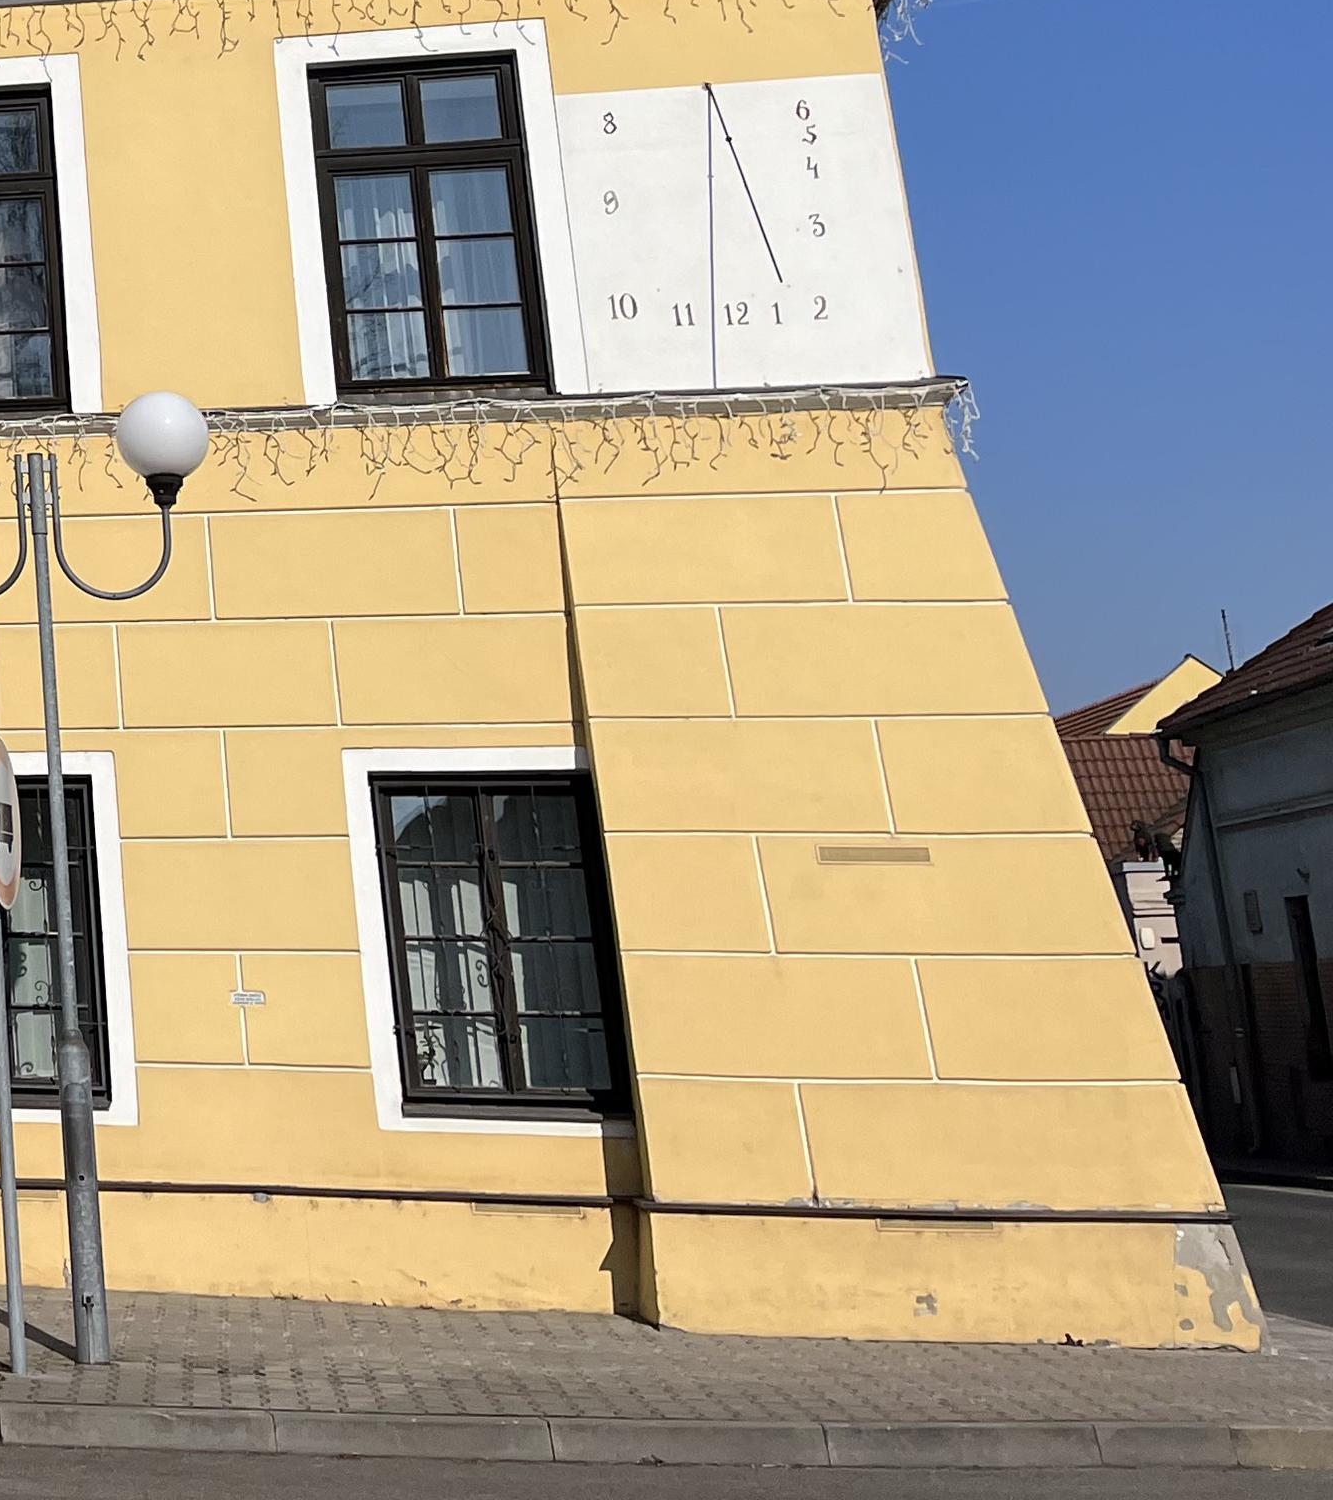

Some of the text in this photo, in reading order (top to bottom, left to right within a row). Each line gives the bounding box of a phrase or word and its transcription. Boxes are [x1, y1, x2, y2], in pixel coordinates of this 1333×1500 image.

[795, 100, 810, 121] 6
[603, 112, 618, 135] 8
[802, 124, 818, 145] 5
[806, 156, 821, 180] 4
[604, 190, 620, 215] 9
[808, 213, 826, 237] 3
[608, 293, 638, 321] 10
[672, 303, 696, 327] 11
[724, 302, 750, 326] 12
[771, 302, 784, 326] 1
[813, 295, 829, 321] 2
